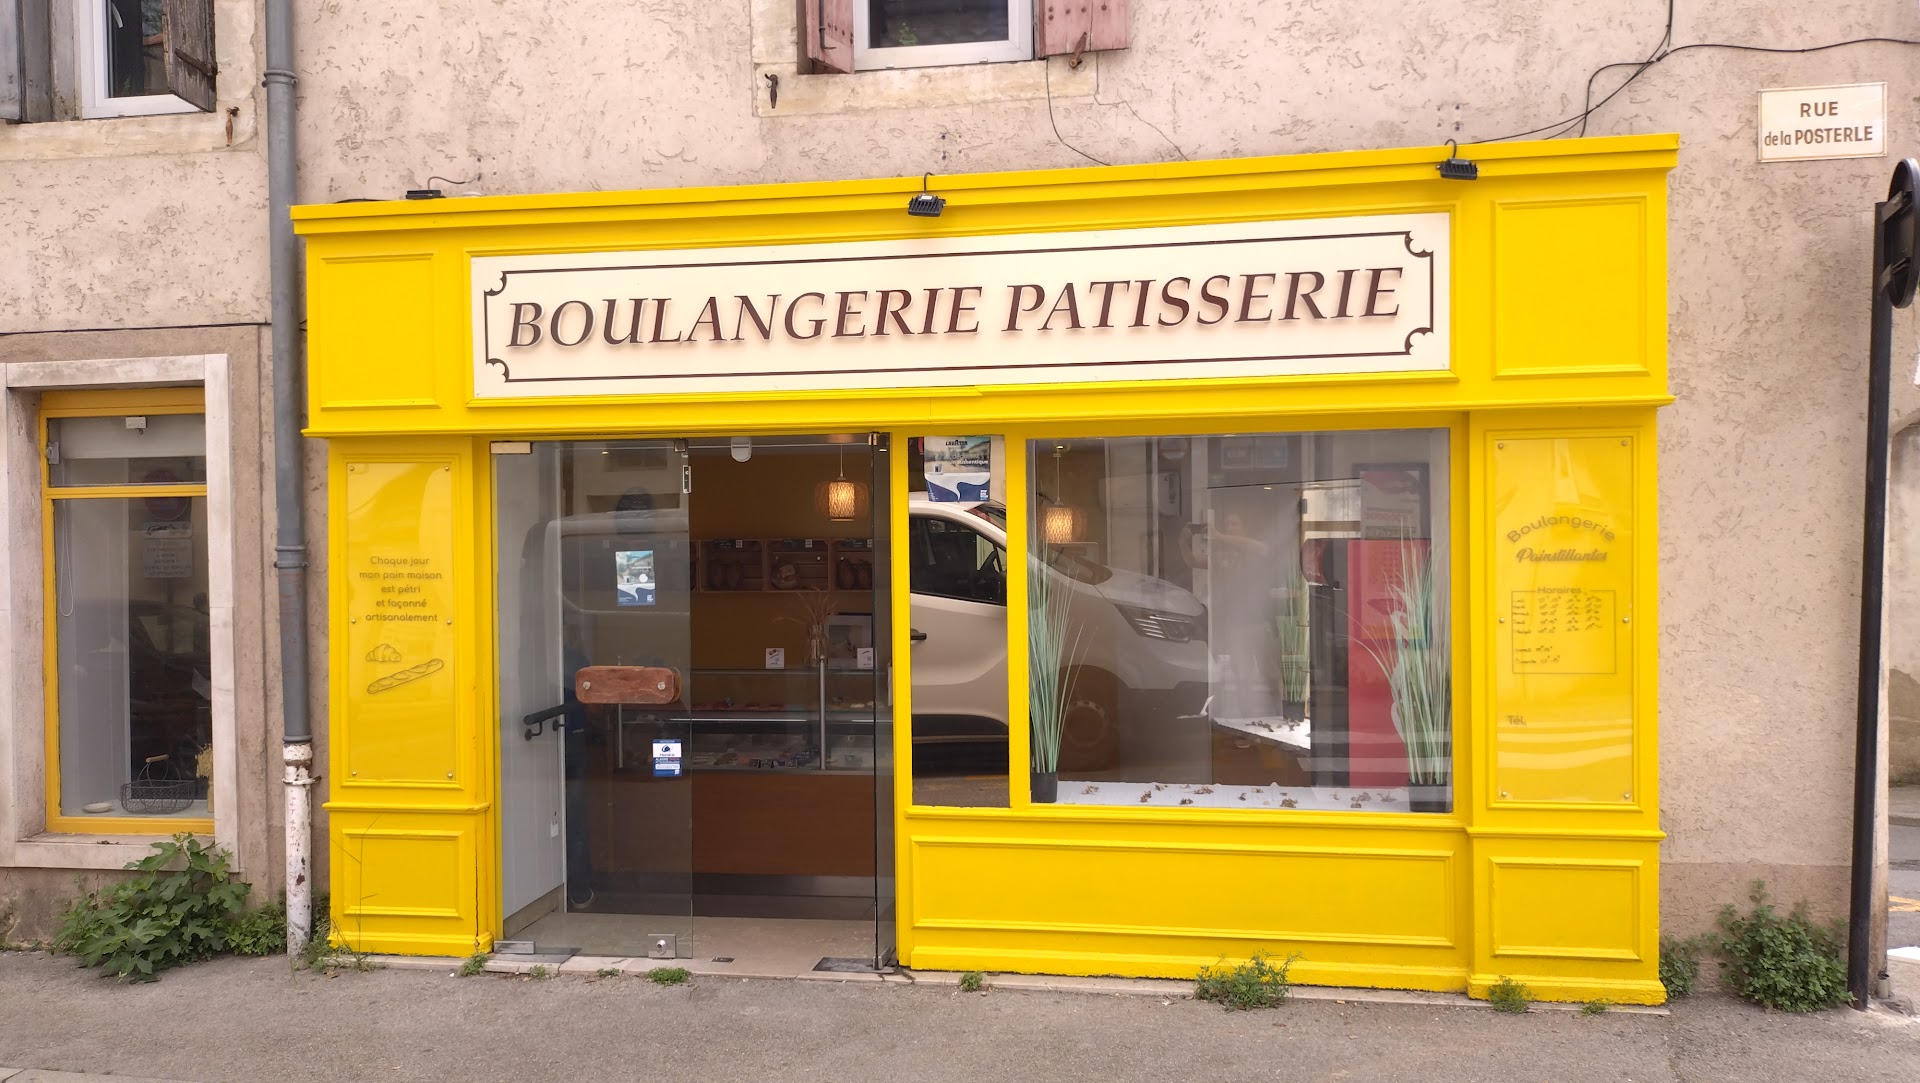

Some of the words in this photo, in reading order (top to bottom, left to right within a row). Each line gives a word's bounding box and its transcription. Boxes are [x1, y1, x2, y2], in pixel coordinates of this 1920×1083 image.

[1800, 101, 1838, 118] RUE
[1764, 131, 1779, 146] de
[1780, 130, 1791, 145] la
[1794, 125, 1873, 145] POSTERLE
[504, 284, 983, 347] BOULANGERIE
[1001, 267, 1403, 332] PATISSERIE
[1506, 515, 1615, 543] Boulangerie
[370, 556, 408, 566] Chaque
[410, 557, 430, 566] jour
[383, 571, 404, 580] pain
[407, 571, 442, 579] maison
[381, 585, 395, 593] est
[398, 585, 421, 594] pétri
[1537, 586, 1582, 594] Horaires
[376, 599, 385, 607] et
[387, 599, 427, 609] façonné
[365, 613, 438, 622] artisanalement
